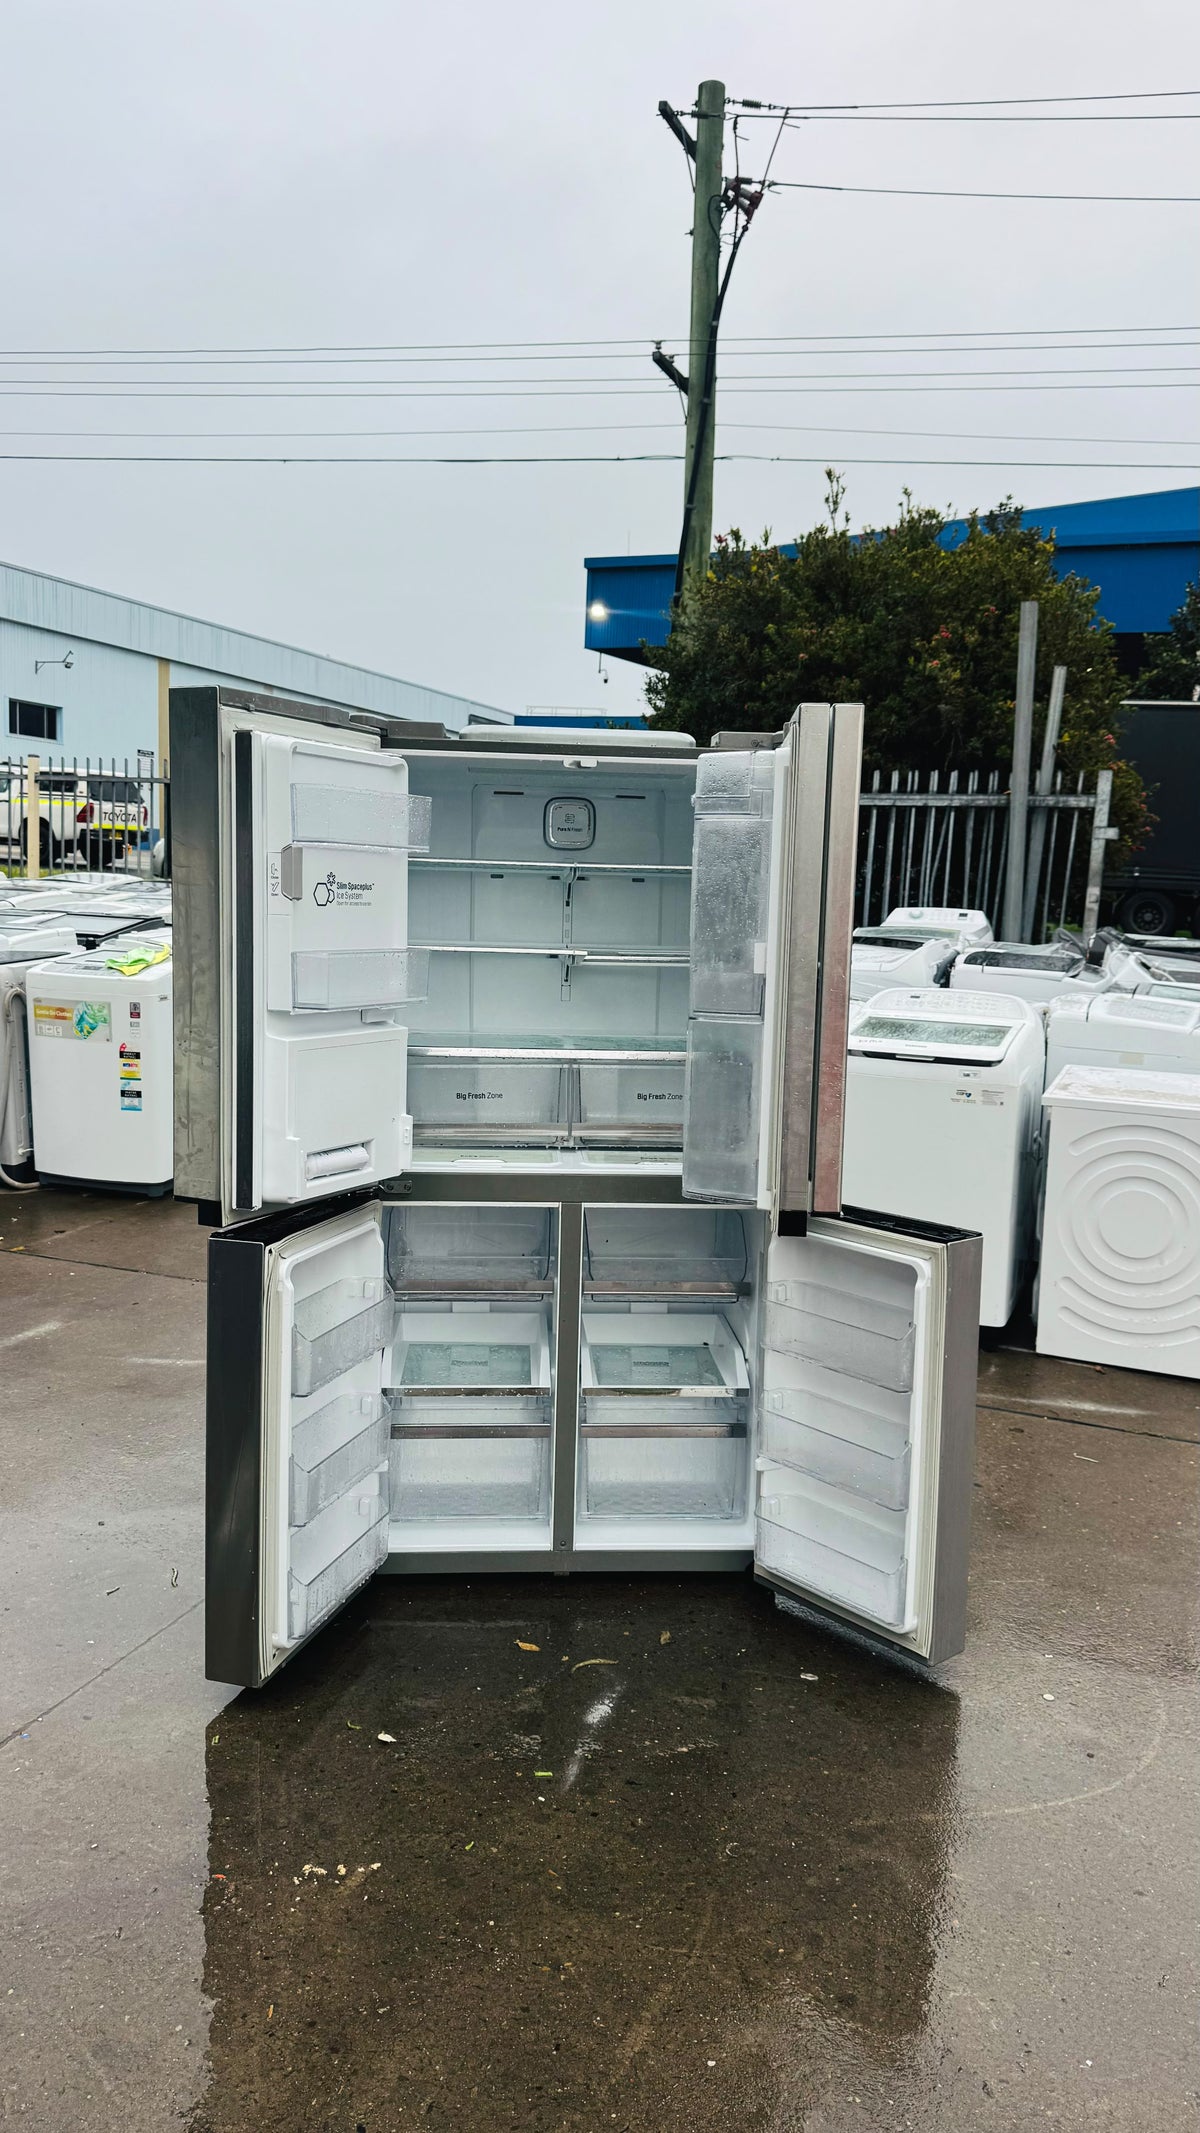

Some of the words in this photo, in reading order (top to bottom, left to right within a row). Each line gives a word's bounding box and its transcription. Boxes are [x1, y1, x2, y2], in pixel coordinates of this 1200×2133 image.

[103, 811, 138, 823] TOYOTA
[336, 881, 348, 890] Slim
[336, 892, 345, 900] Ice
[345, 892, 364, 901] System
[456, 1092, 467, 1101] Big
[467, 1092, 486, 1100] Fresh
[486, 1091, 503, 1100] Zone
[637, 1093, 647, 1101] Big
[667, 1093, 683, 1101] Zone
